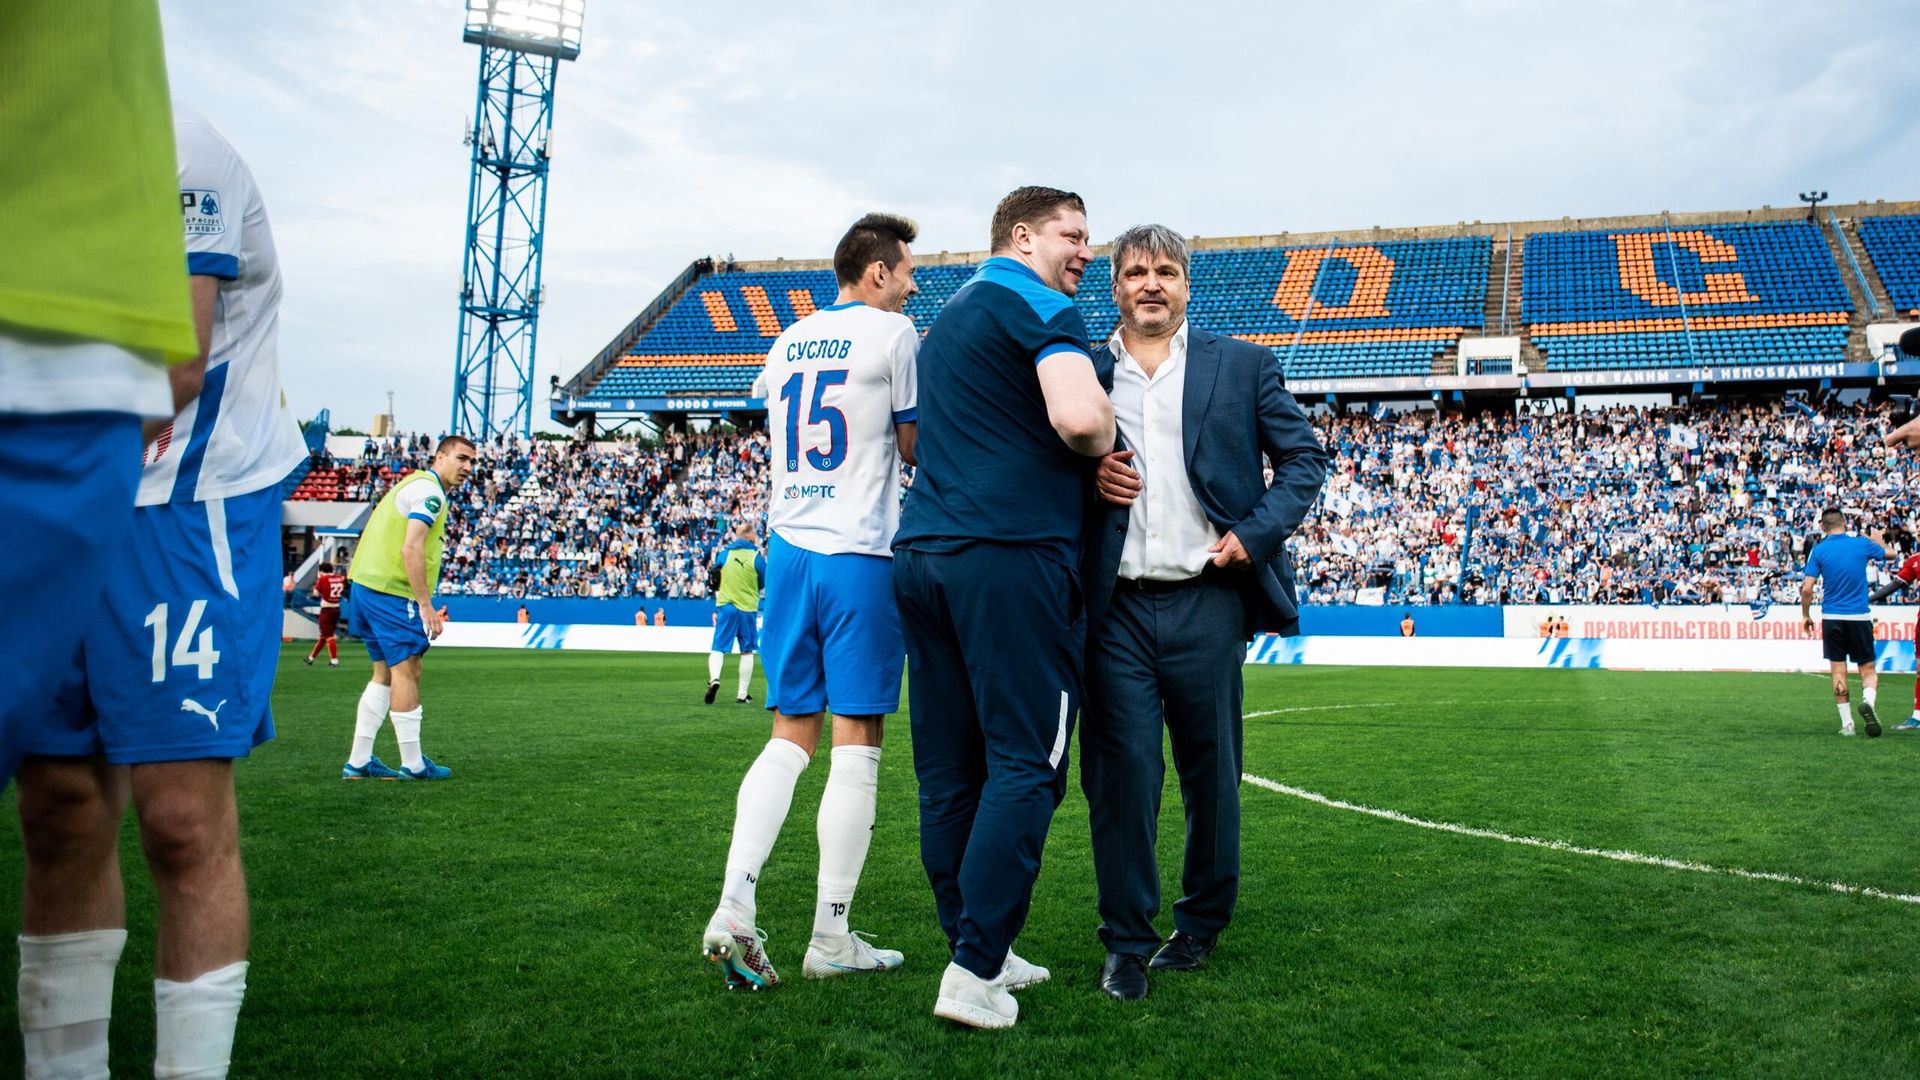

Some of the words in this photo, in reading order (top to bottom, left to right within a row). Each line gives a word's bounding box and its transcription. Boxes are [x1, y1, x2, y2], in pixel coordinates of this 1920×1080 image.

[787, 339, 852, 362] СУСЛОВ
[1561, 373, 1605, 385] ПОКА
[1612, 370, 1668, 384] ЕДИНЫ
[1688, 368, 1713, 380] МЫ
[1720, 363, 1845, 380] НЕПОБЕДИМЫ!
[779, 369, 850, 473] 15
[330, 583, 344, 597] 22
[1584, 620, 1731, 640] ПРАВИТЕЛЬСТВО
[1877, 622, 1916, 640] ОБЛ
[144, 600, 221, 683] 14
